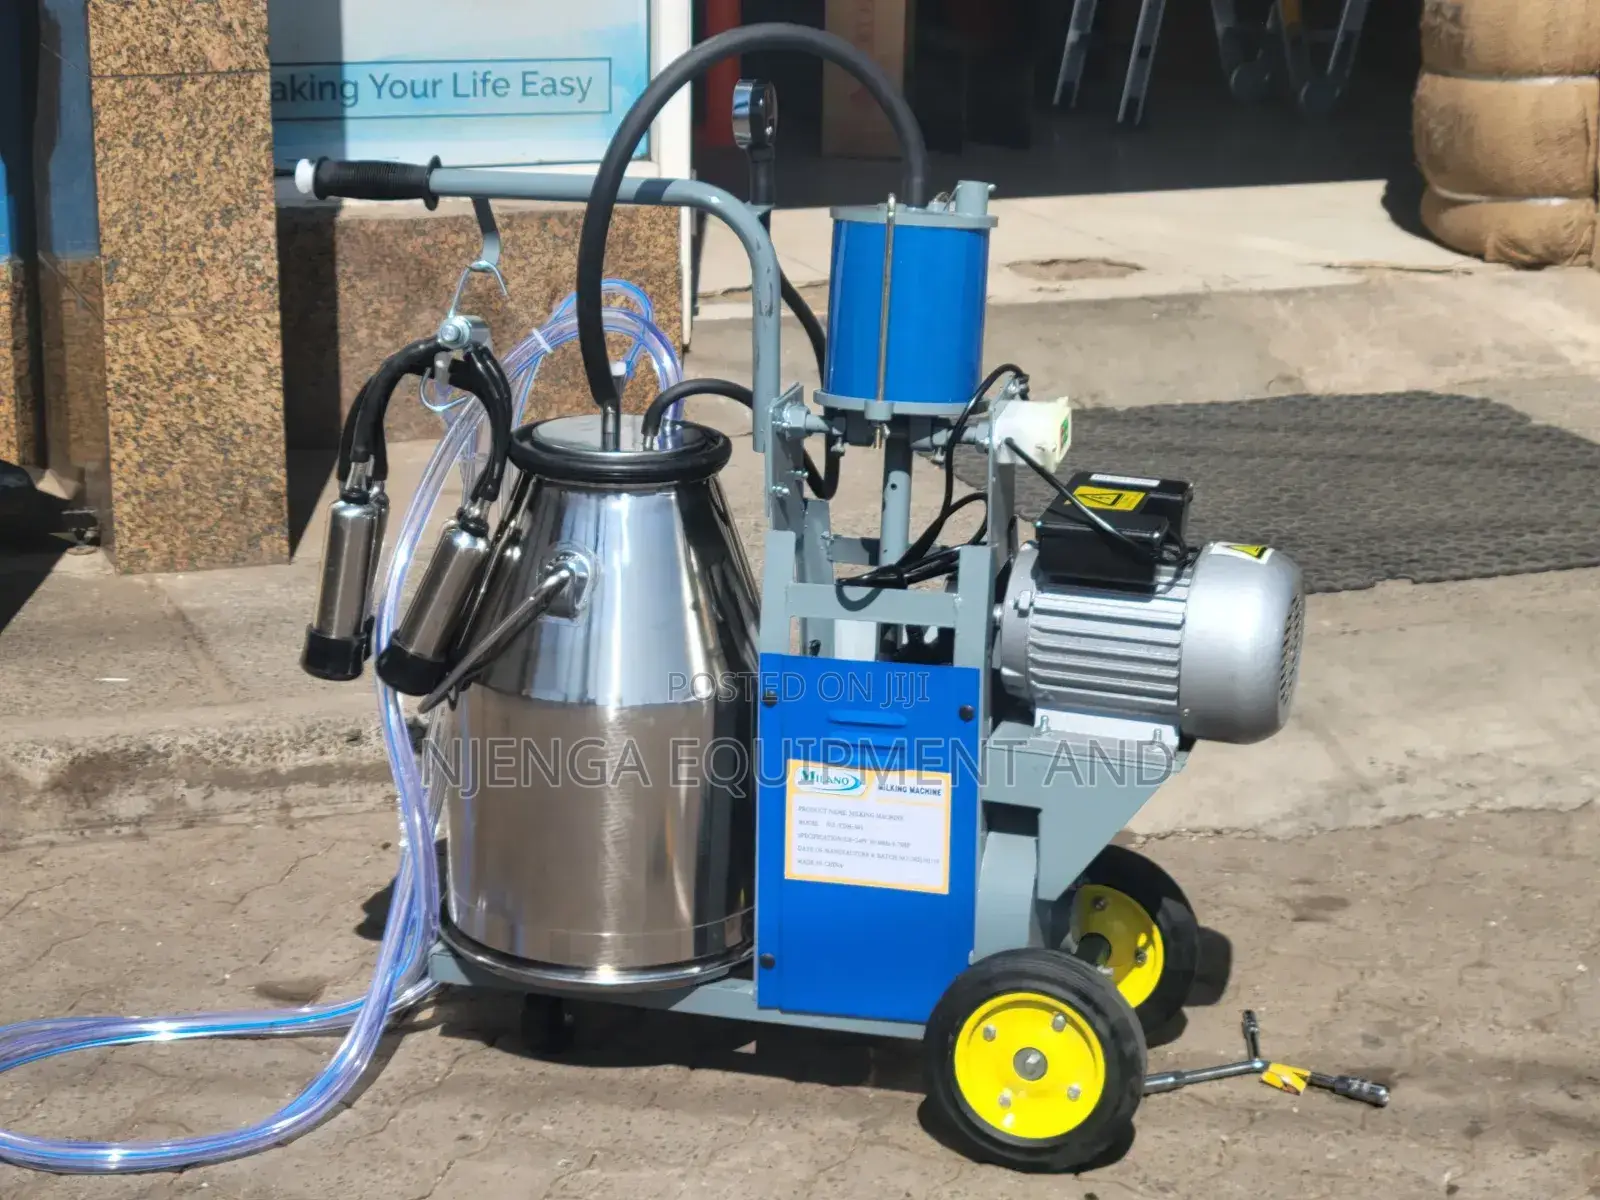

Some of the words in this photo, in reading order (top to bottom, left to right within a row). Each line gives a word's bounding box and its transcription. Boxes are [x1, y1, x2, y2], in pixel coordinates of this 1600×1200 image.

[271, 74, 358, 108] aking
[369, 72, 443, 100] Your
[453, 70, 510, 98] Life
[521, 70, 592, 103] Easy
[878, 785, 907, 793] MILKING
[910, 786, 942, 796] MACHINE
